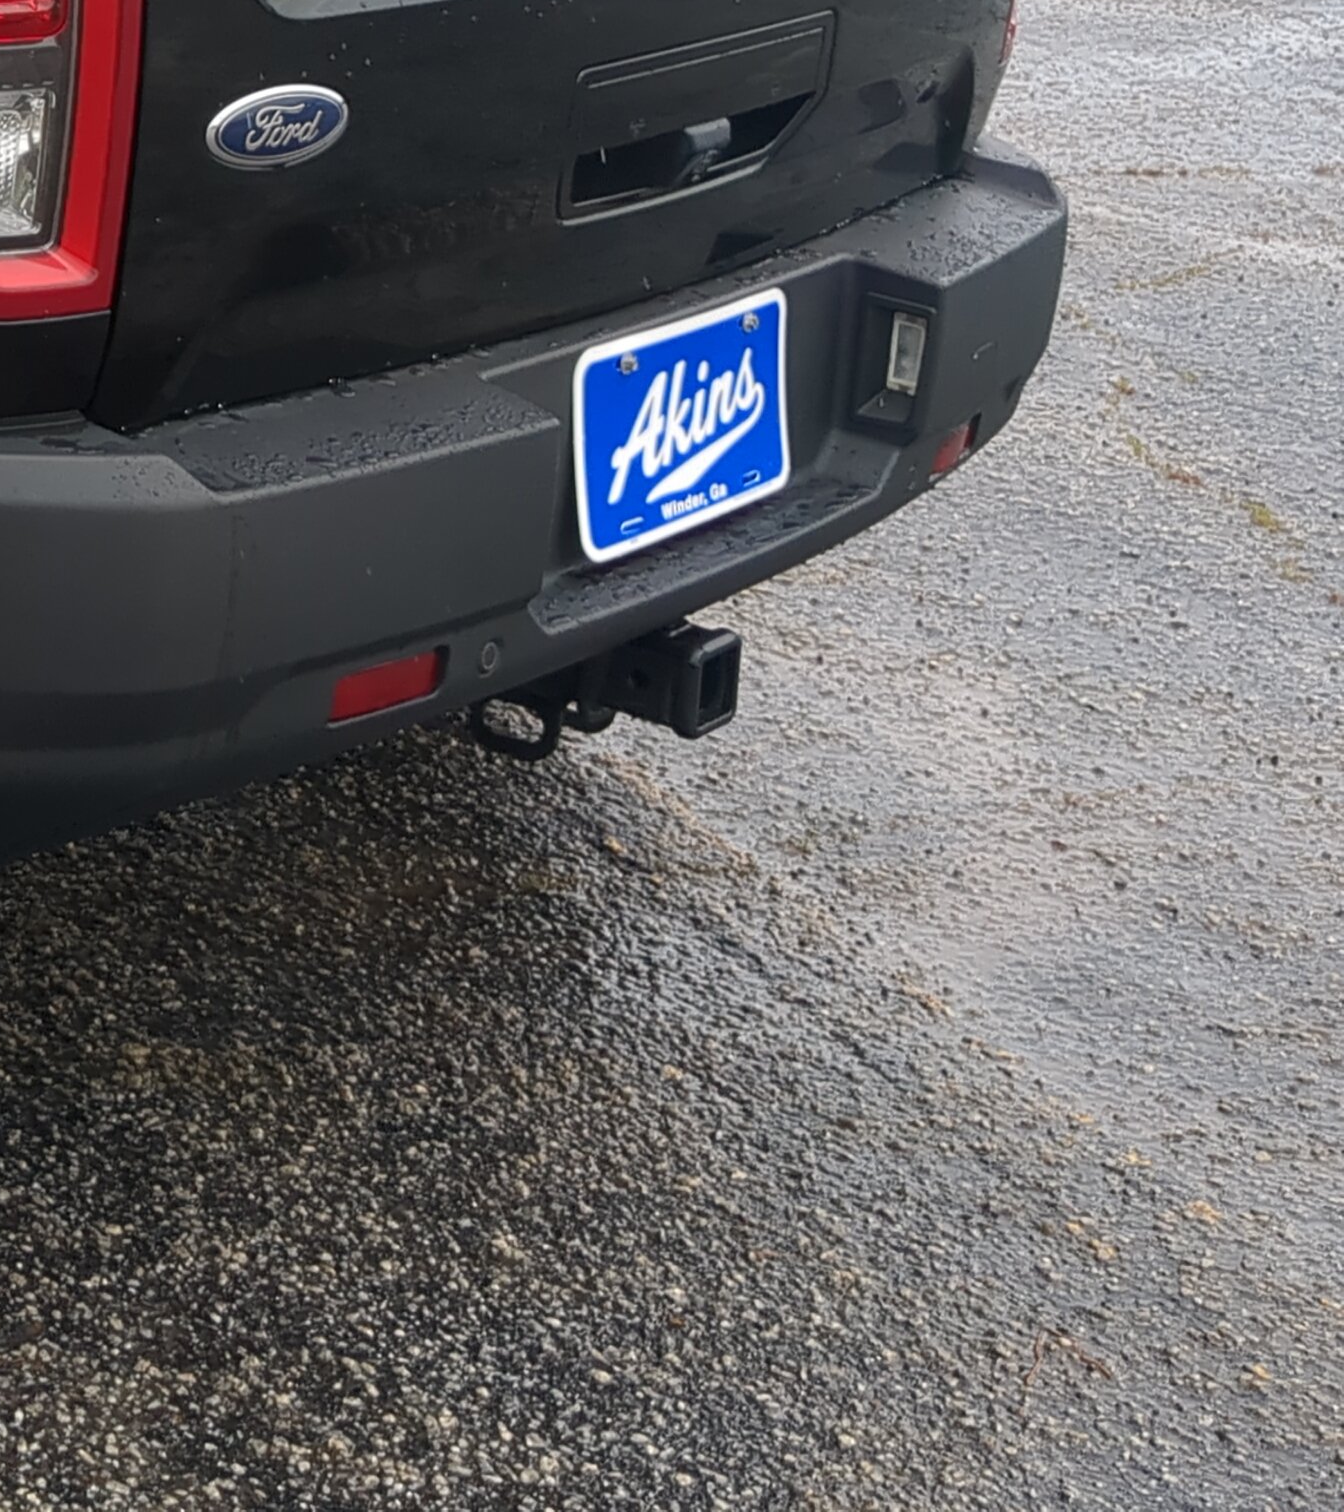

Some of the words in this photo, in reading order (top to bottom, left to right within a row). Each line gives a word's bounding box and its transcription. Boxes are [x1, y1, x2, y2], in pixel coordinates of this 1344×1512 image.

[245, 103, 323, 152] Ford
[608, 347, 764, 505] Akins
[660, 492, 709, 520] Winder,
[709, 482, 728, 501] Ga
